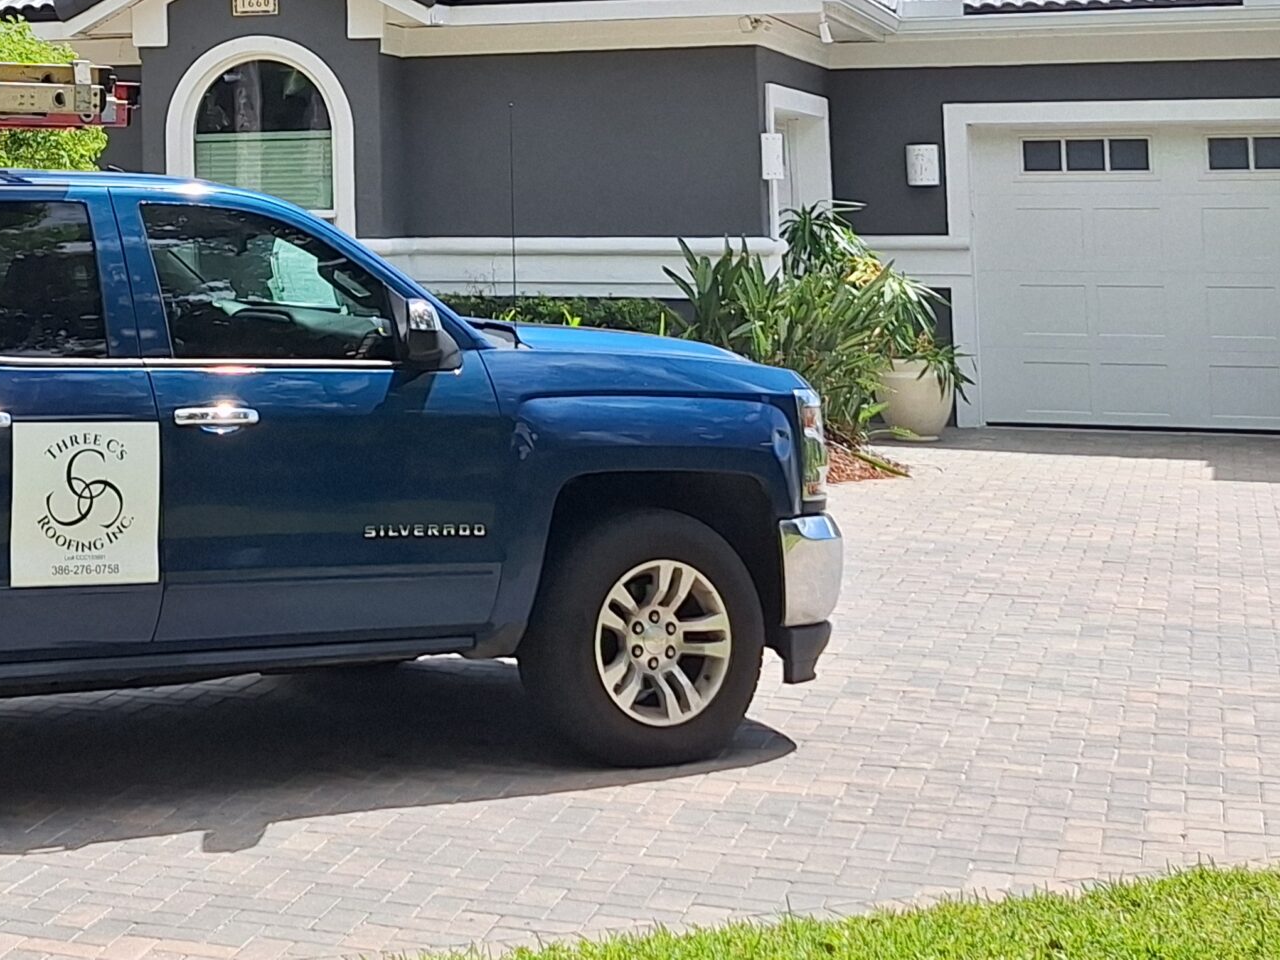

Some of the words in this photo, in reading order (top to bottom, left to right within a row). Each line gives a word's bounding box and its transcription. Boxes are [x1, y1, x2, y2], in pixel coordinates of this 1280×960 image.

[44, 432, 102, 460] THREE
[37, 515, 104, 553] ROOFING
[364, 524, 486, 538] SILVERADO
[51, 564, 120, 576] 386-276-0758
